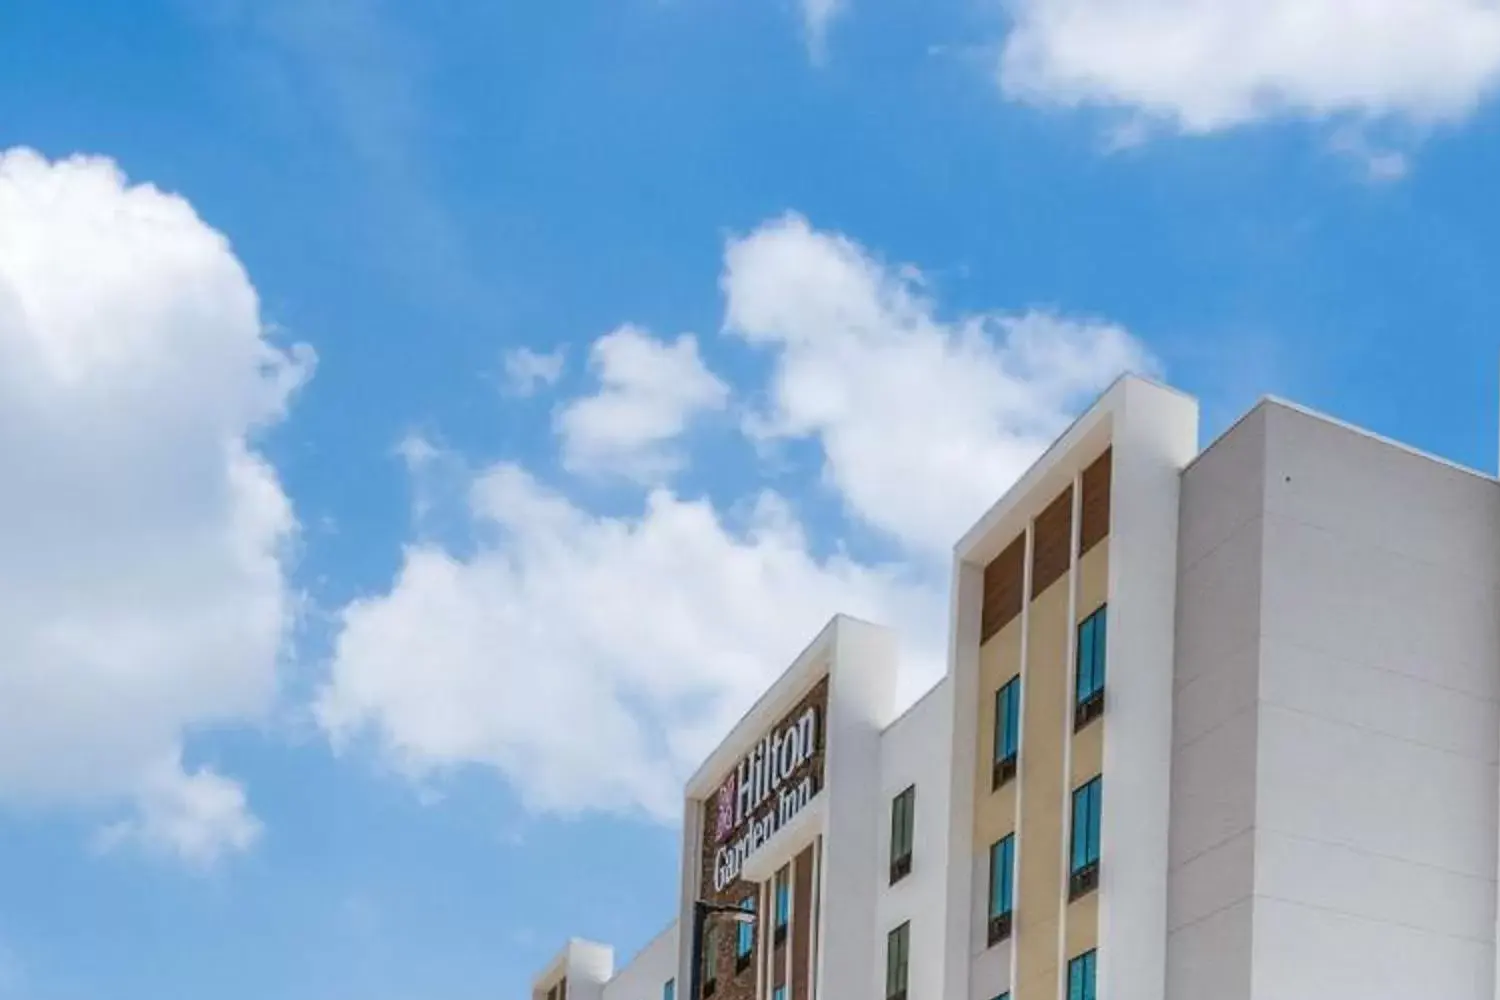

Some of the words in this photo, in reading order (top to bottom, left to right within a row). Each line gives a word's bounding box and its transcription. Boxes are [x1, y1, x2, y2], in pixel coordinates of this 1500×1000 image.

[735, 707, 815, 827] Hilton
[714, 809, 776, 892] Garden
[778, 775, 812, 826] Inn
